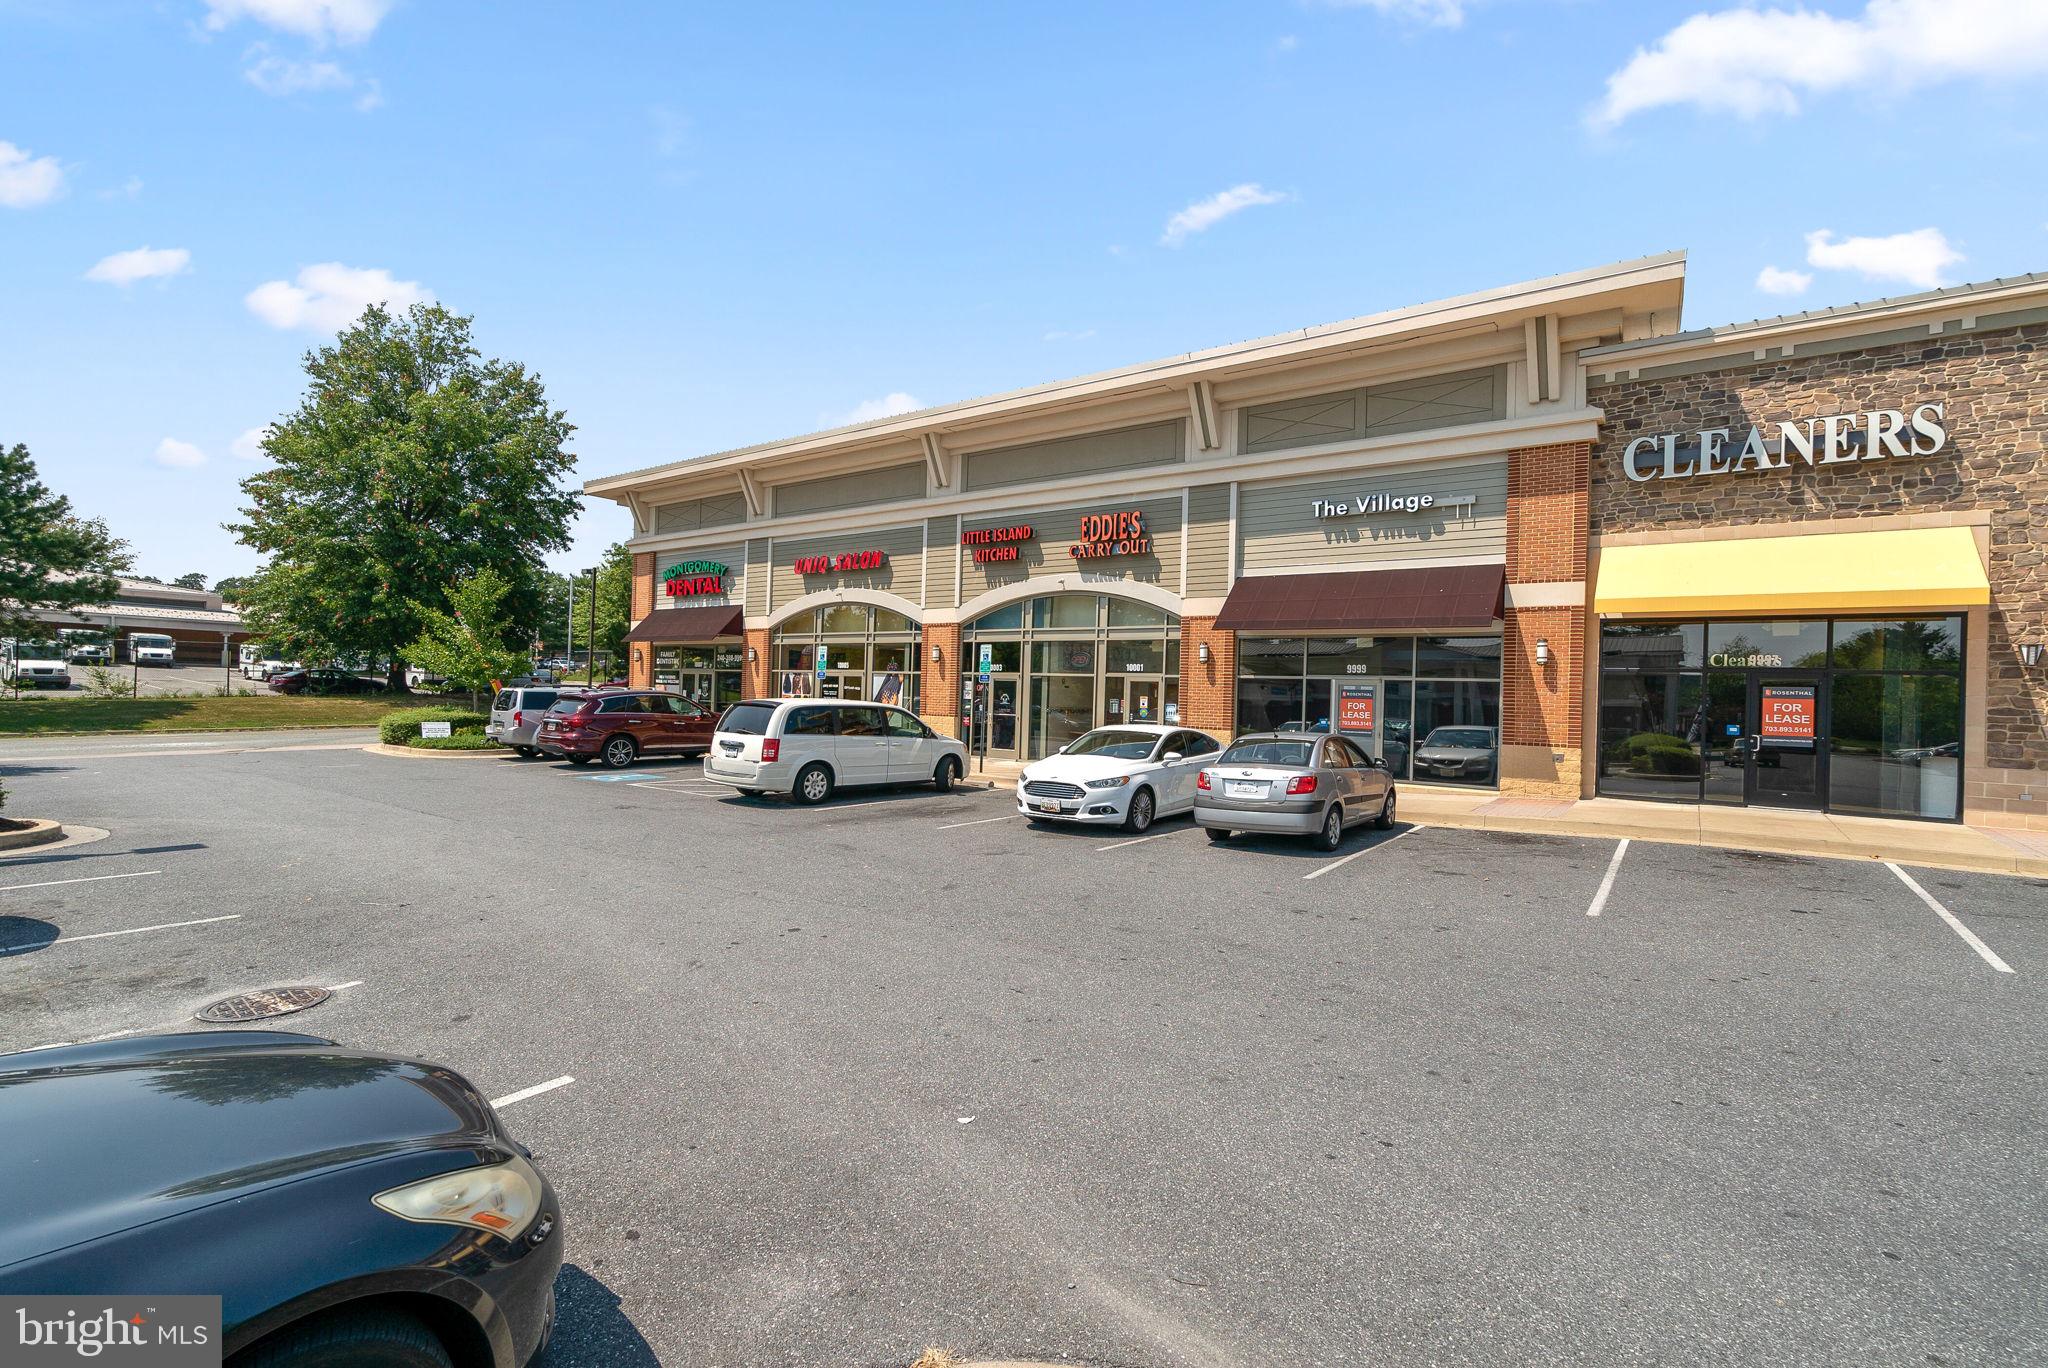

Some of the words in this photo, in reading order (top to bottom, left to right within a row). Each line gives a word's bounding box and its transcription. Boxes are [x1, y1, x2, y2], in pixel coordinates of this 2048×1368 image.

[1623, 402, 1947, 482] CLEANERS
[1311, 499, 1349, 518] The
[1356, 493, 1434, 513] Village
[961, 529, 991, 545] LITTLE
[993, 524, 1033, 543] ISLAND
[1080, 511, 1143, 543] EDDIE'S
[975, 547, 1018, 562] KITCHEN
[1068, 541, 1113, 559] CARRY
[1119, 539, 1149, 555] OUT
[662, 560, 729, 581] MONTGOMERY
[794, 555, 829, 575] UNIQ
[834, 550, 884, 572] SALON
[666, 576, 723, 597] DENTAL
[1126, 663, 1144, 672] 10001
[1346, 664, 1367, 673] 9999
[1342, 711, 1371, 719] LEASE
[1347, 702, 1366, 710] FOR
[1773, 703, 1802, 712] FOR
[1765, 714, 1811, 724] LEASE
